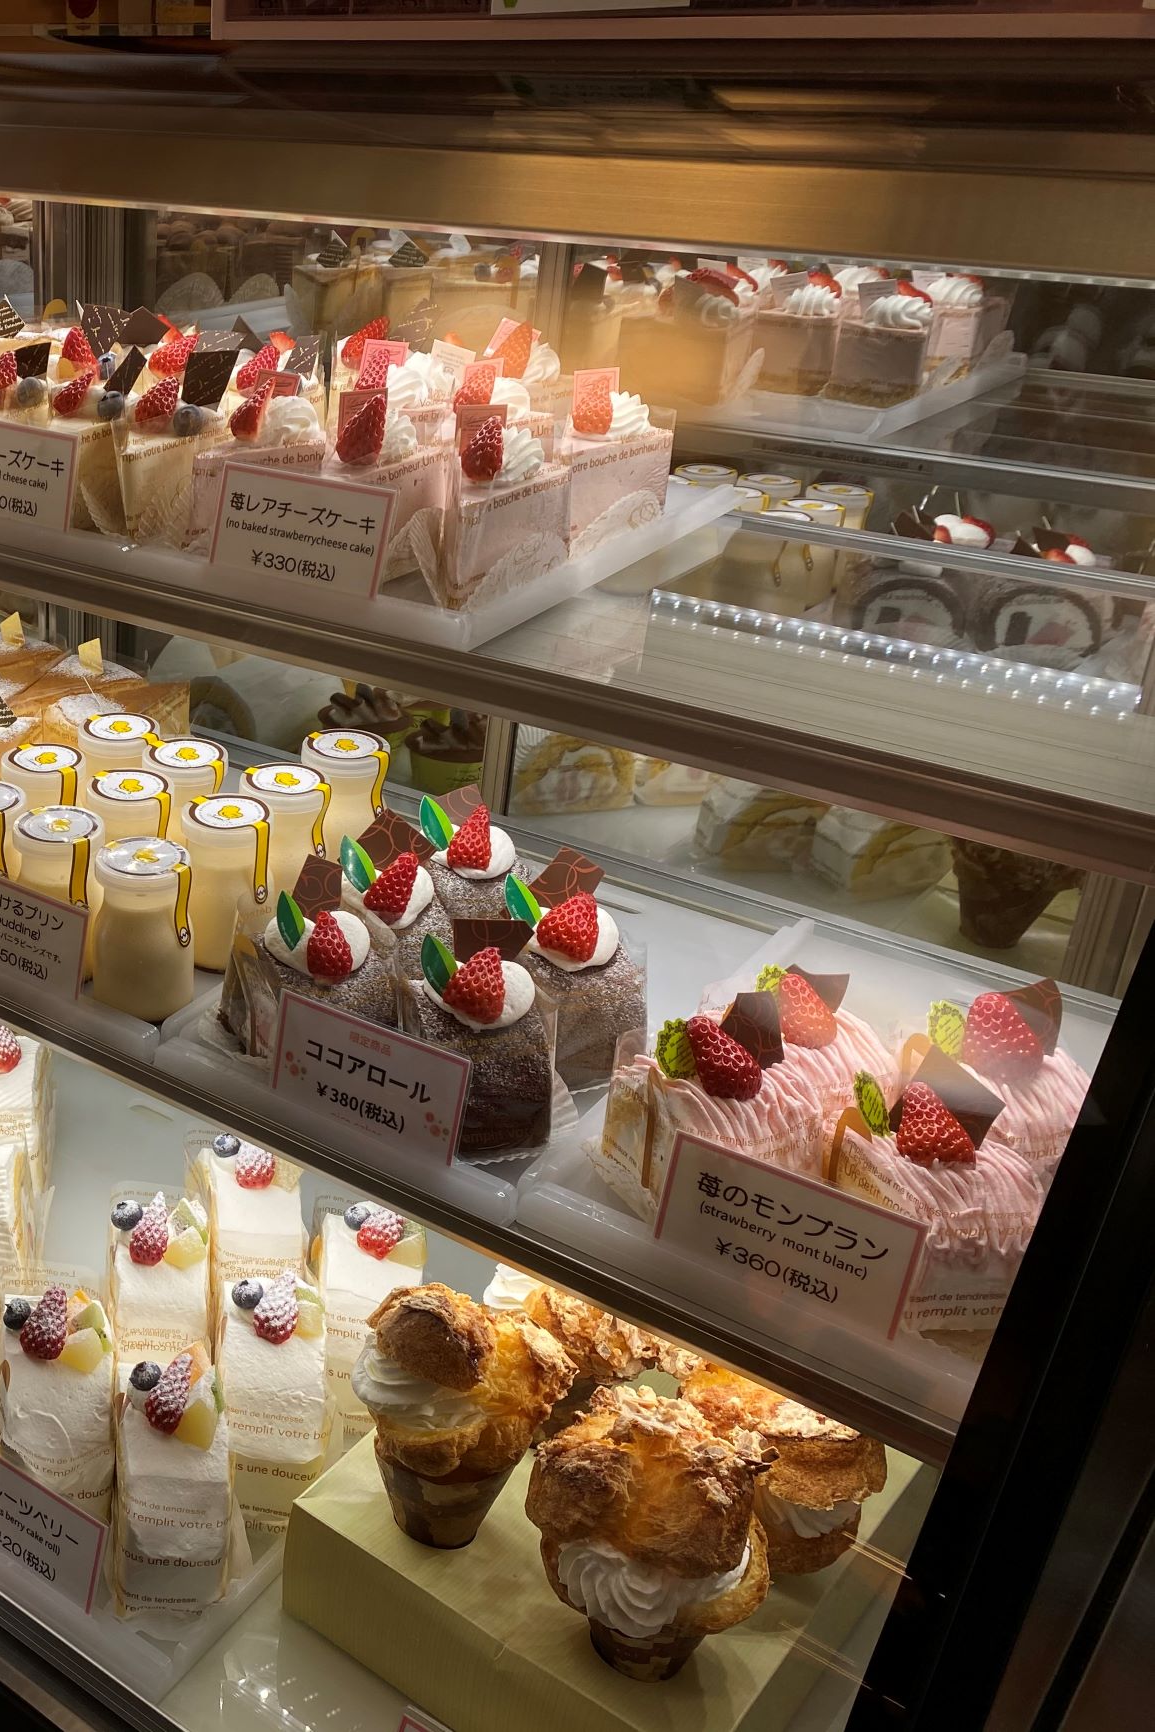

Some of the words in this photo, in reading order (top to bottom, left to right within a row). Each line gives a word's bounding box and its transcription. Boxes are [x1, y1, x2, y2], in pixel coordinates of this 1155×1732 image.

[2, 470, 27, 486] cheese
[28, 477, 48, 492] cake)
[493, 491, 521, 513] bouche
[229, 491, 376, 536] 苺レアチーズケーキ
[226, 516, 240, 530] (no
[241, 518, 268, 535] baked
[269, 526, 348, 551] strawberrycheese
[349, 542, 376, 558] cake)
[250, 548, 337, 583] ¥330(税込)
[306, 1039, 431, 1104] ココアロール
[316, 1080, 405, 1134] ¥380(税込)
[696, 1171, 888, 1260] 苺のモンブラン
[700, 1200, 777, 1242] (strawberry
[782, 1236, 820, 1258] mont
[822, 1250, 868, 1282] blanc)
[714, 1237, 838, 1304] ¥360(税込)
[939, 1293, 952, 1302] de
[917, 1305, 967, 1320] remplit
[249, 1410, 260, 1418] de
[262, 1410, 305, 1424] tendresse
[232, 1420, 274, 1436] remplit
[278, 1429, 310, 1441] votre
[246, 1464, 268, 1475] une
[271, 1465, 318, 1482] douceur
[149, 1503, 161, 1511] de
[162, 1504, 206, 1516] tendresse
[239, 1502, 250, 1510] de
[132, 1512, 174, 1528] remplit
[179, 1519, 214, 1530] votre
[6, 1512, 26, 1532] berry
[26, 1526, 44, 1545] cake
[44, 1538, 61, 1558] roll)
[146, 1558, 171, 1568] une
[172, 1556, 222, 1568] douceur
